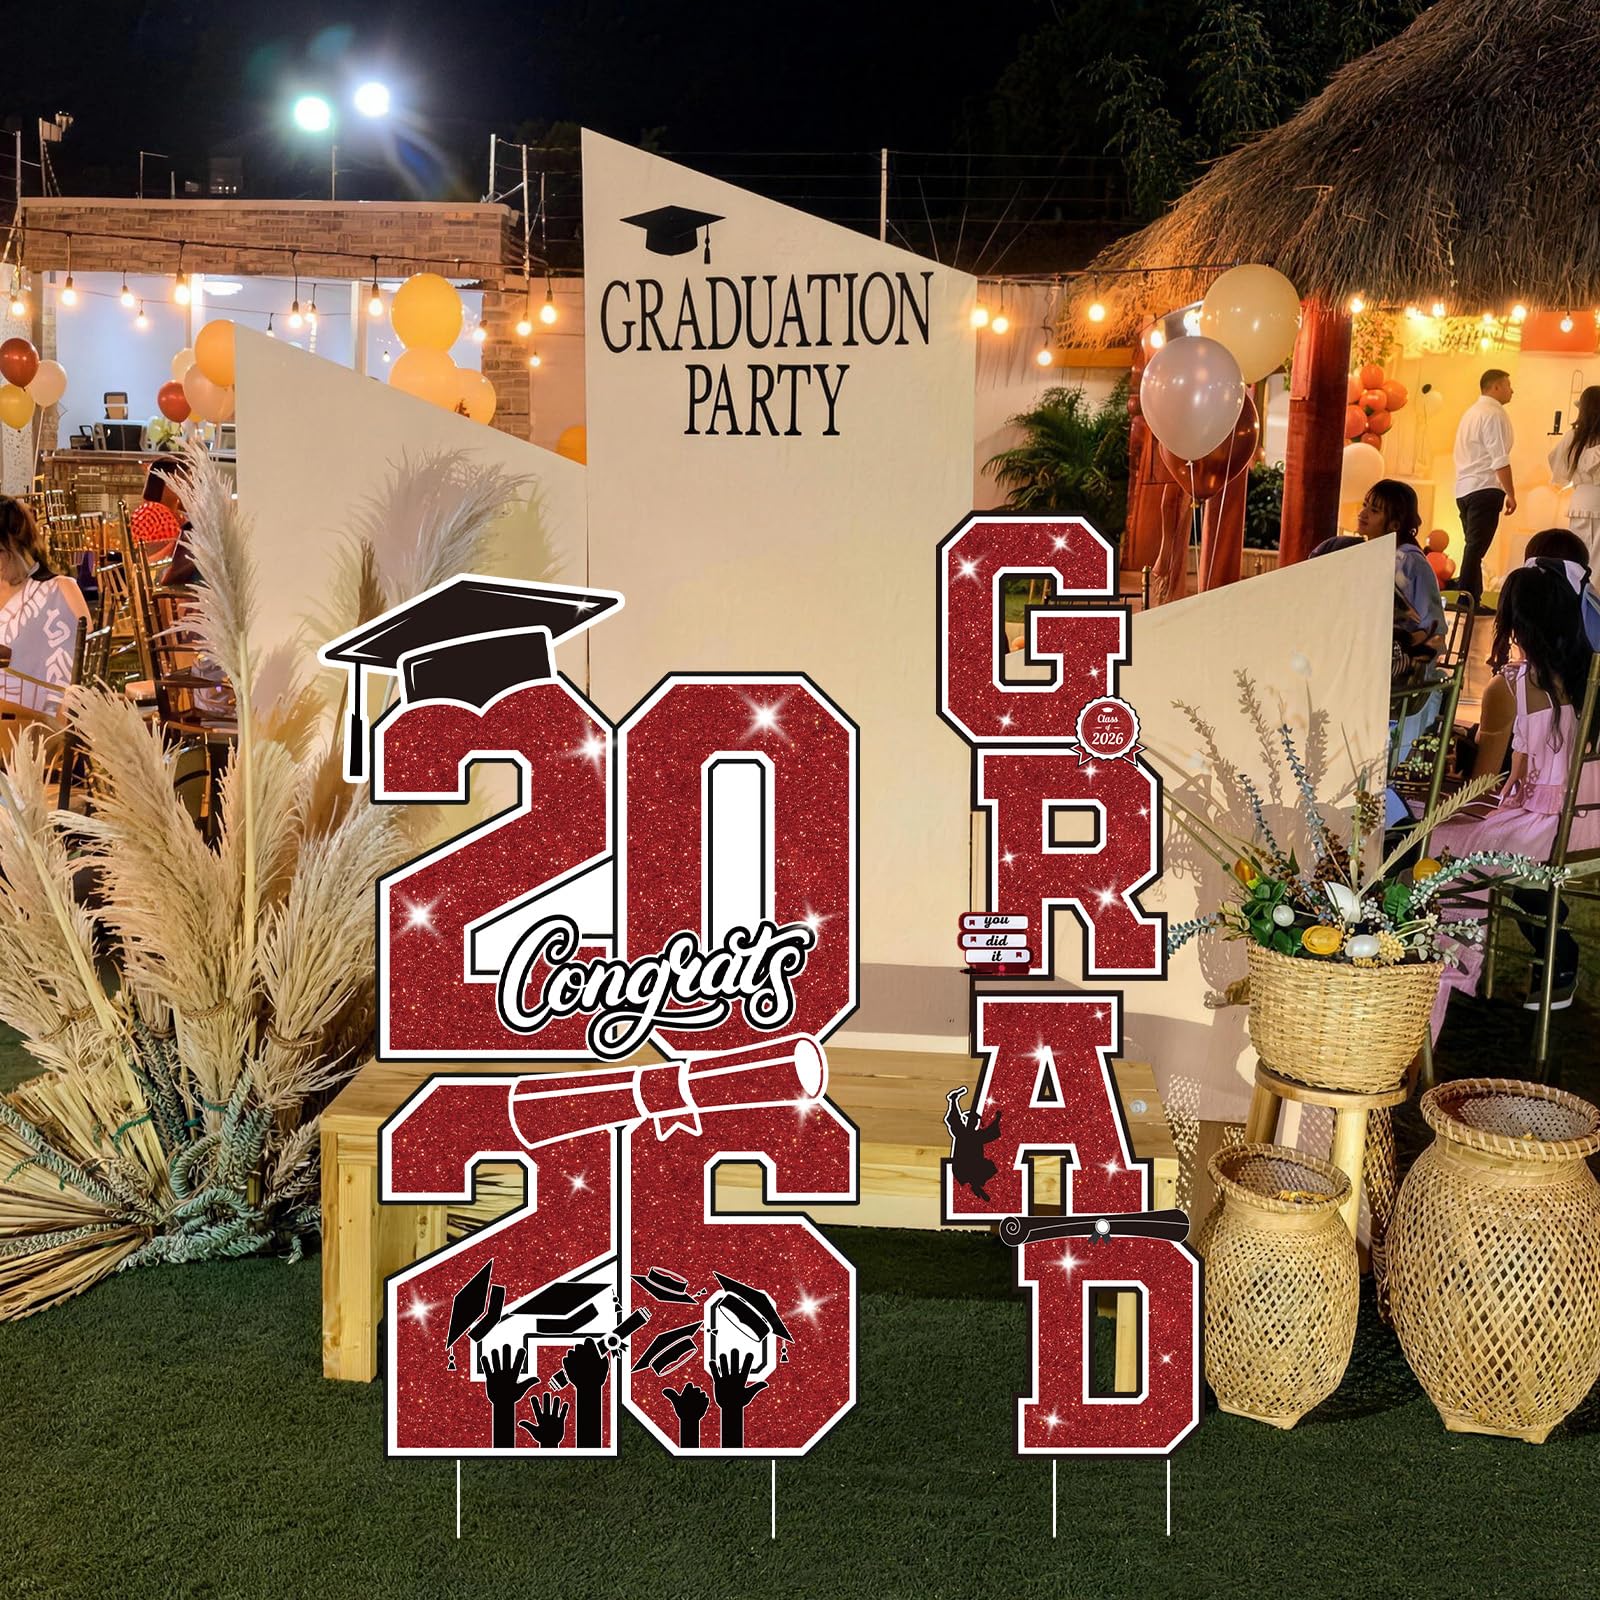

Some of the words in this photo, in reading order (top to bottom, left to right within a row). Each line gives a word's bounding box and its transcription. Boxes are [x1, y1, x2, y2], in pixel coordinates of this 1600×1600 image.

[600, 271, 934, 353] GRADUATION
[684, 363, 850, 436] PARTY
[1091, 732, 1124, 745] 2026
[1097, 714, 1119, 723] Class
[370, 671, 860, 1062] 20
[984, 916, 1010, 928] you
[985, 935, 1009, 946] did
[991, 950, 1003, 962] it
[499, 915, 816, 1060] Congrats
[377, 1072, 860, 1459] 26
